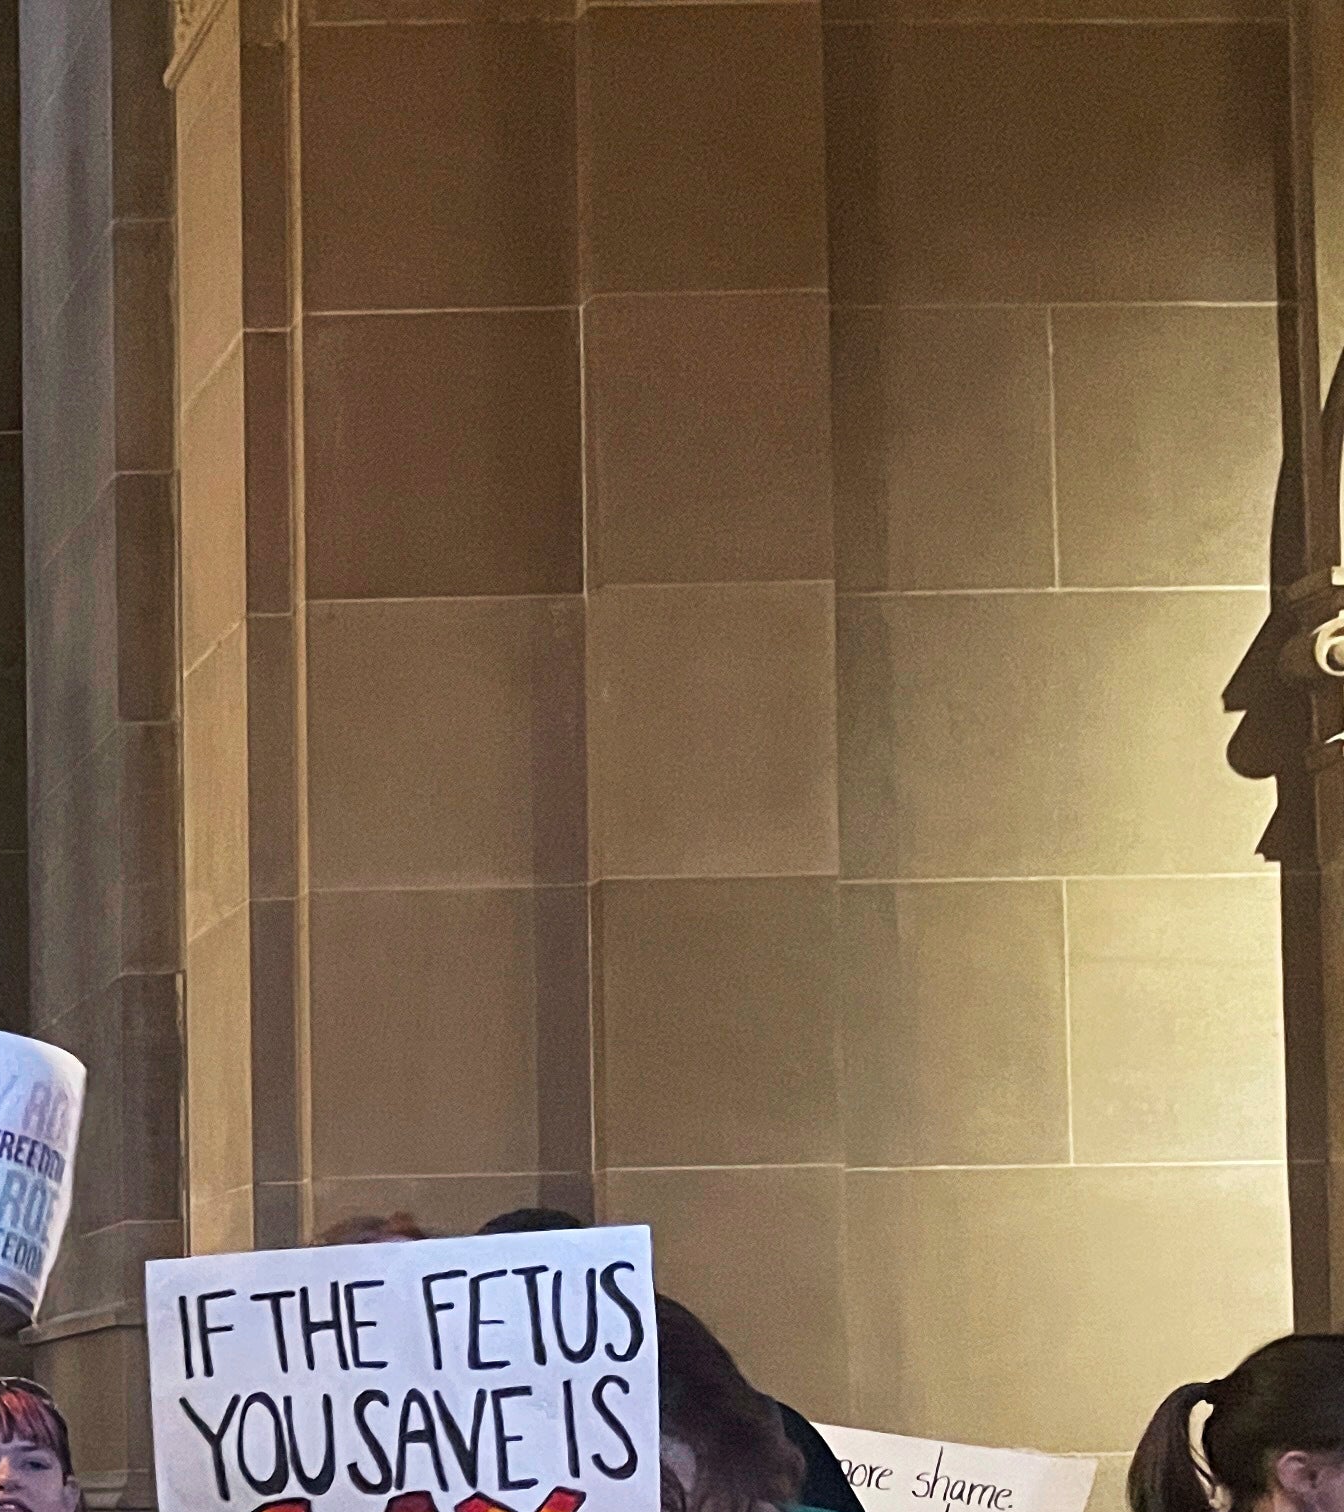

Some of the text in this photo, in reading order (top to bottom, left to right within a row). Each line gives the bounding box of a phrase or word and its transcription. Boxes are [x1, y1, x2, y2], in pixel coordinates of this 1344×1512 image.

[178, 1261, 645, 1379] IF THE FETUS
[179, 1375, 639, 1501] YOU SAVE IS
[911, 1446, 1014, 1510] shame.
